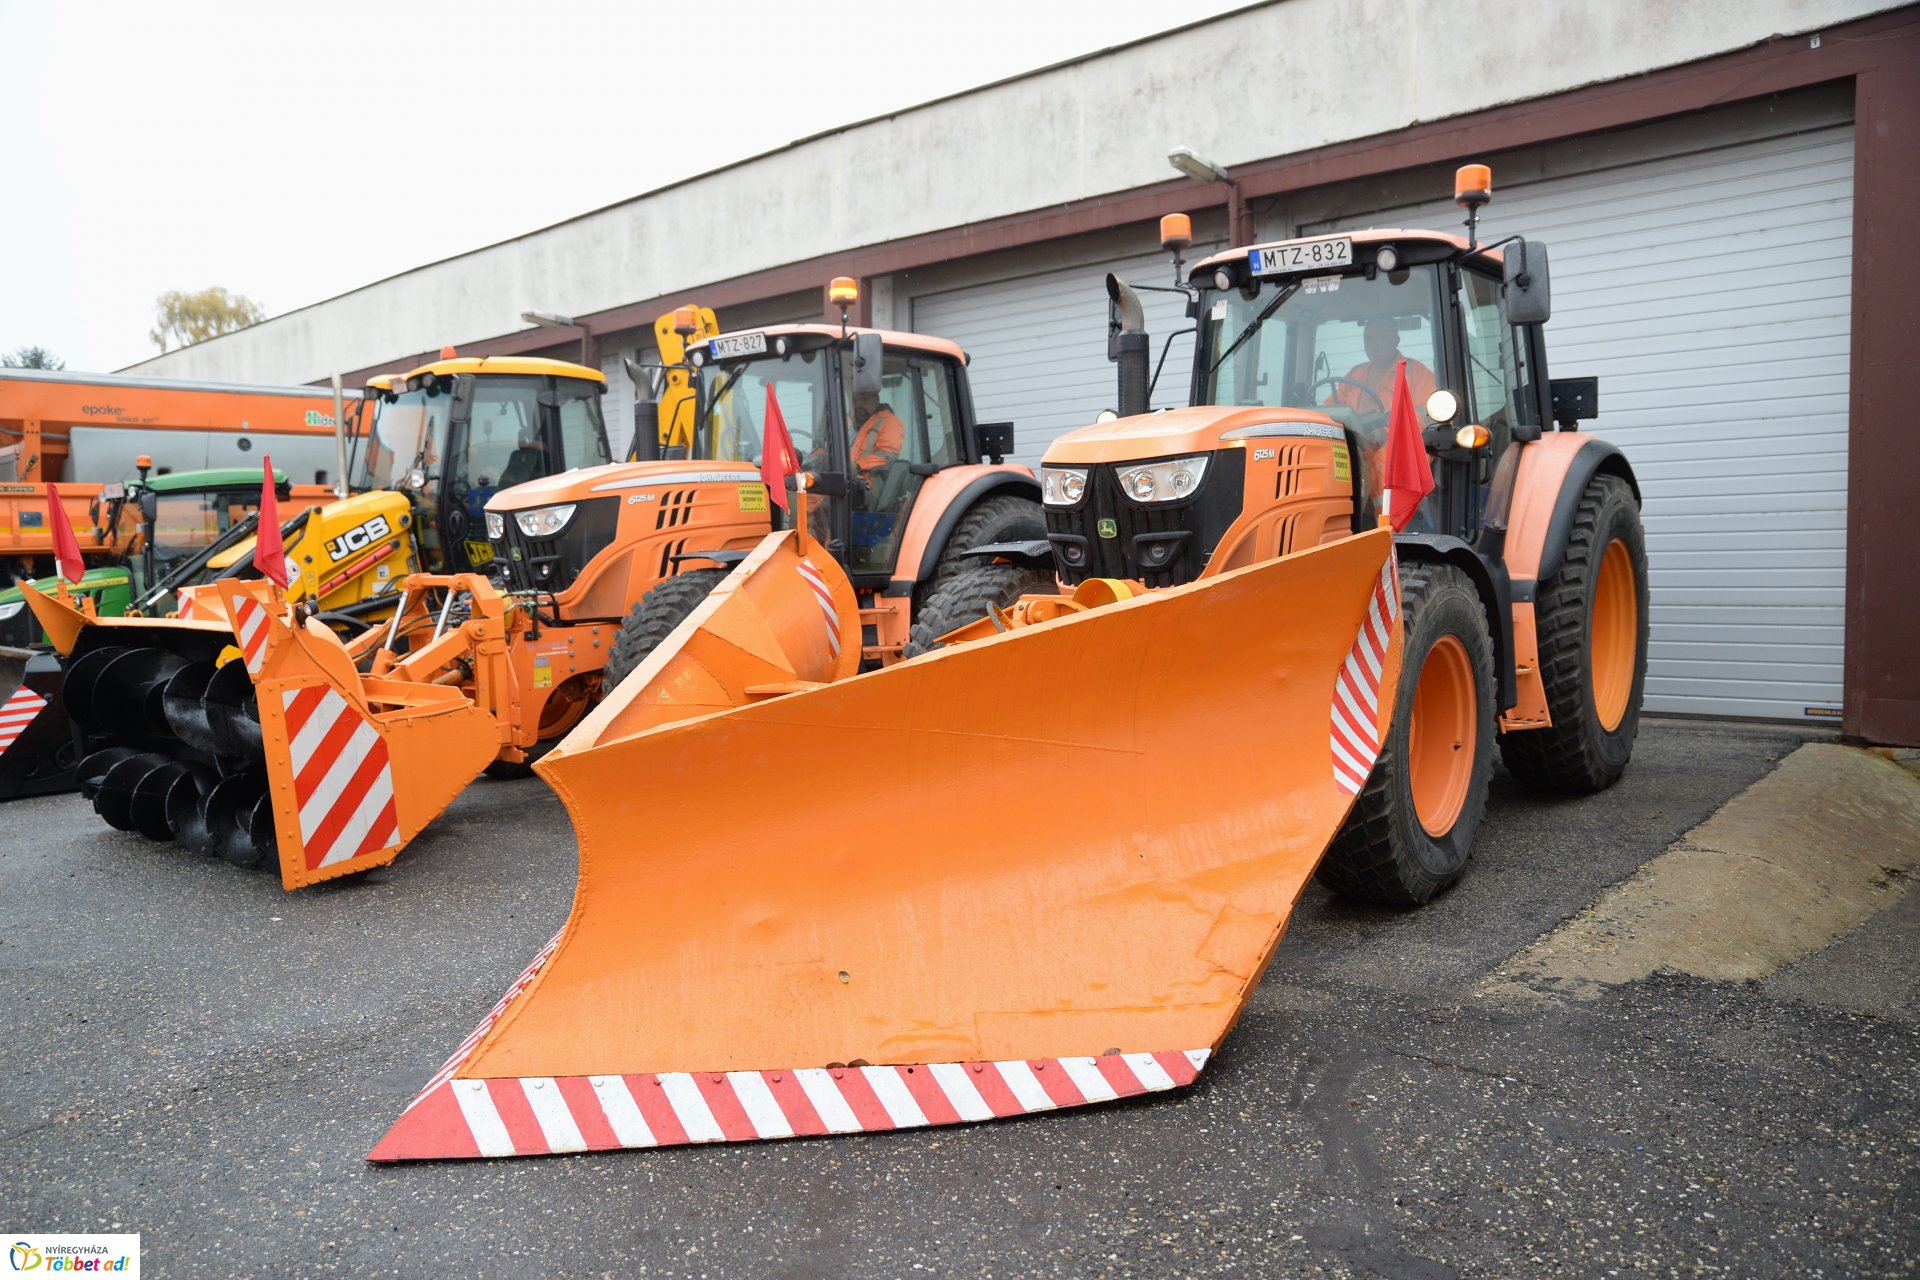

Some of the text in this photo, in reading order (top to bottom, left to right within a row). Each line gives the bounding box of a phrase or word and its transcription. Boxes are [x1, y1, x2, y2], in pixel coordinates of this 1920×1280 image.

[1263, 241, 1347, 269] MTZ-832
[717, 335, 761, 353] MTZ-827
[82, 404, 123, 415] epoke
[329, 515, 391, 561] JCB
[470, 543, 495, 564] JCB
